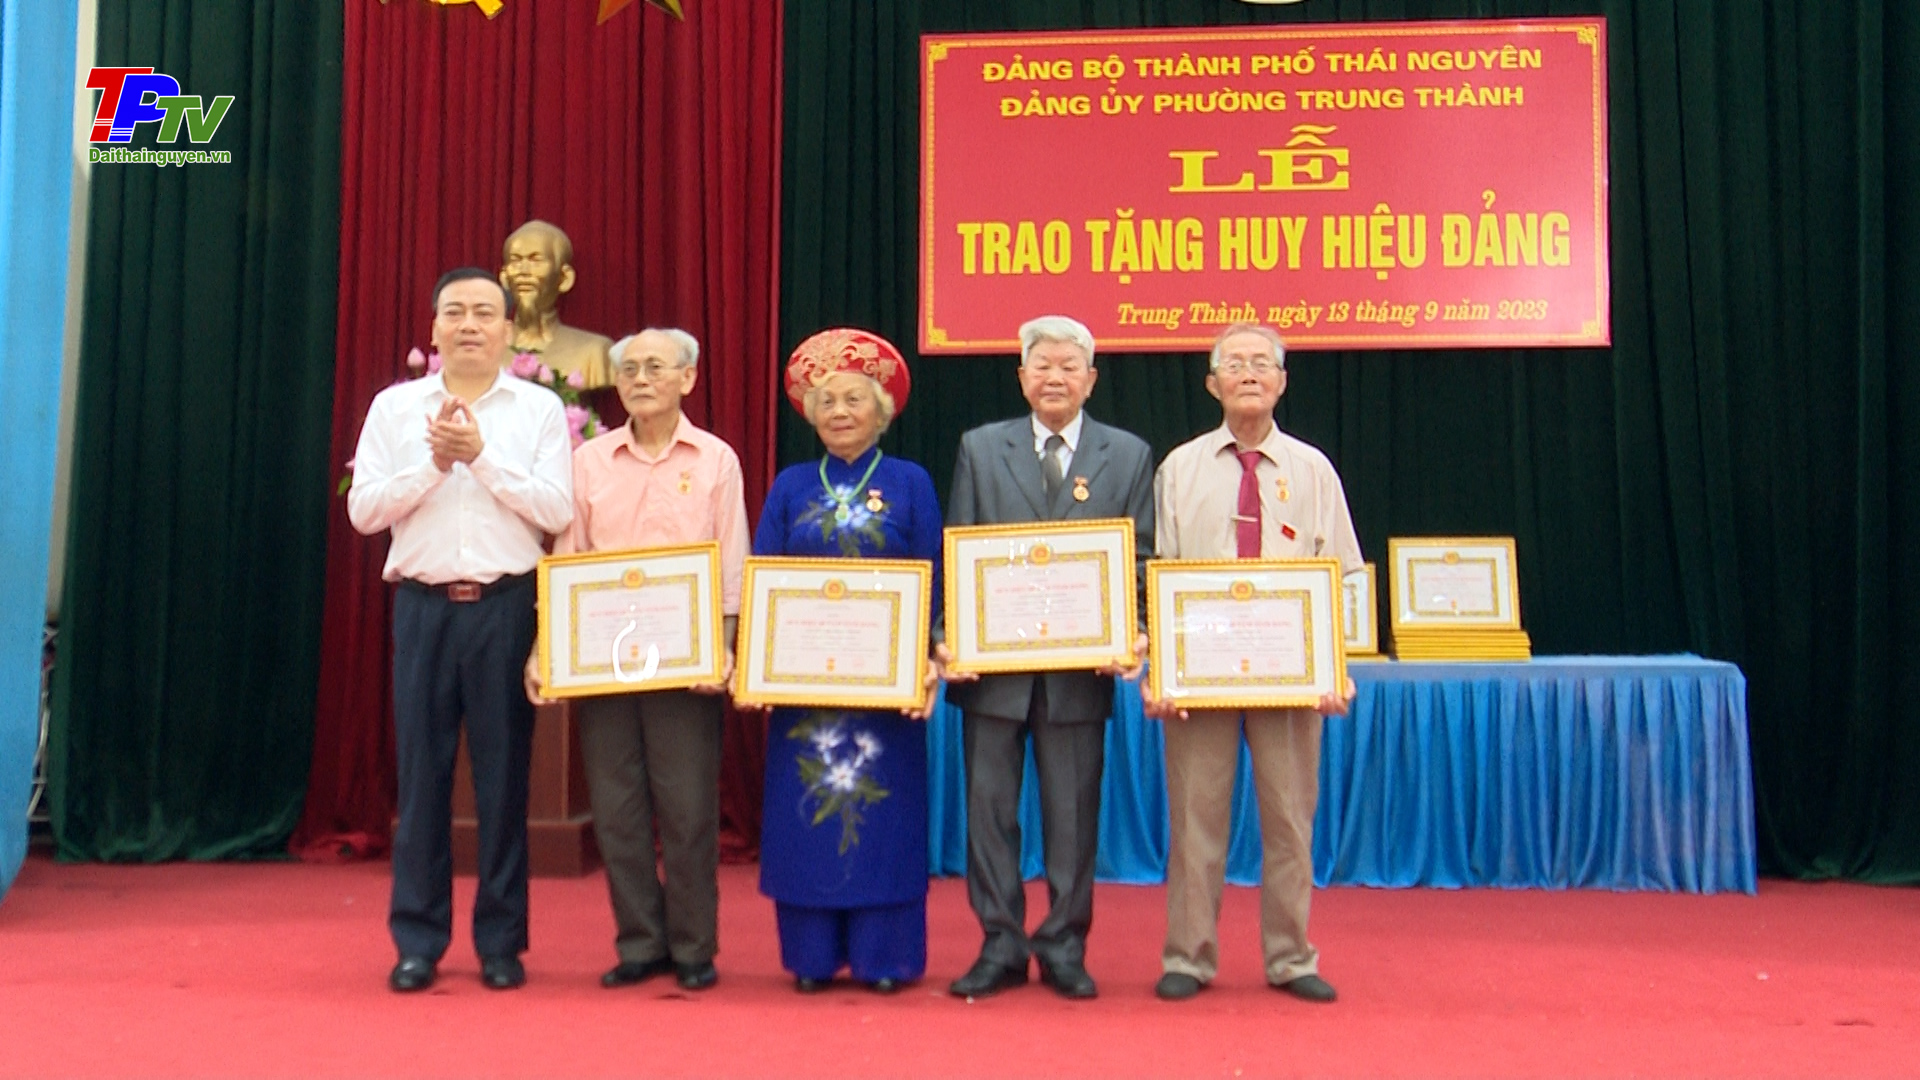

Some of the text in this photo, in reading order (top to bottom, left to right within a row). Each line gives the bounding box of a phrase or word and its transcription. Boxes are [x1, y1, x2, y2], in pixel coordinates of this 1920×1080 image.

[982, 44, 1542, 84] ĐẢNG BỘ THÀNH PHỐ THÁI NGUYÊN
[1000, 82, 1524, 117] ĐẢNG ỦY PHƯỜNG TRUNG THÀNH
[1168, 124, 1350, 193] LỄ
[956, 189, 1571, 285] TRAO TẶNG HUY HIỆU ĐẢNG
[1117, 303, 1184, 331] Trung
[1266, 299, 1323, 329] ngày
[1326, 301, 1350, 323] 13
[1355, 299, 1420, 328] tháng
[1424, 300, 1439, 321] 9
[1443, 297, 1490, 321] năm
[1497, 299, 1549, 320] 2023
